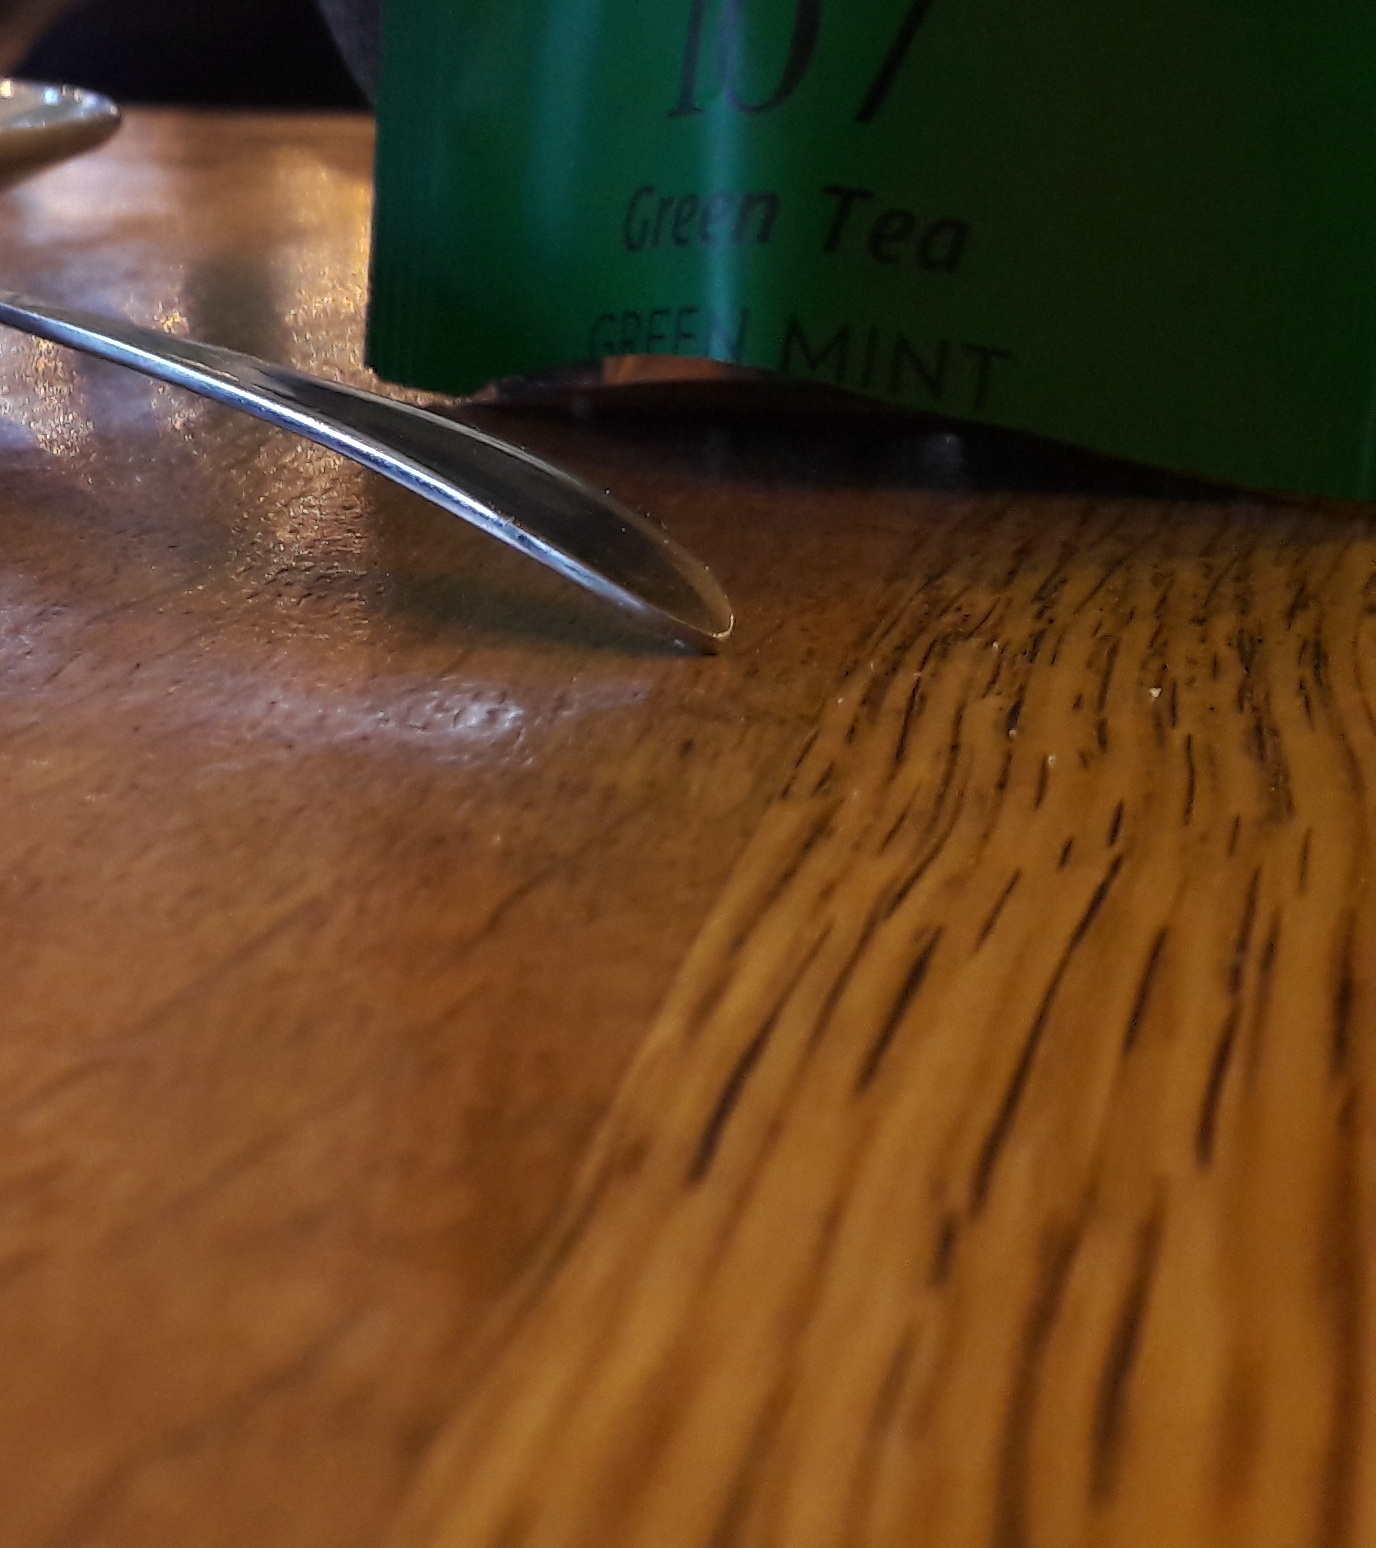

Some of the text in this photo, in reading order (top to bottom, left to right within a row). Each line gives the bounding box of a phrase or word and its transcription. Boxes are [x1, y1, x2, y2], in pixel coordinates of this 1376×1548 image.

[622, 183, 975, 274] Green Tea
[778, 311, 1017, 412] MINT
